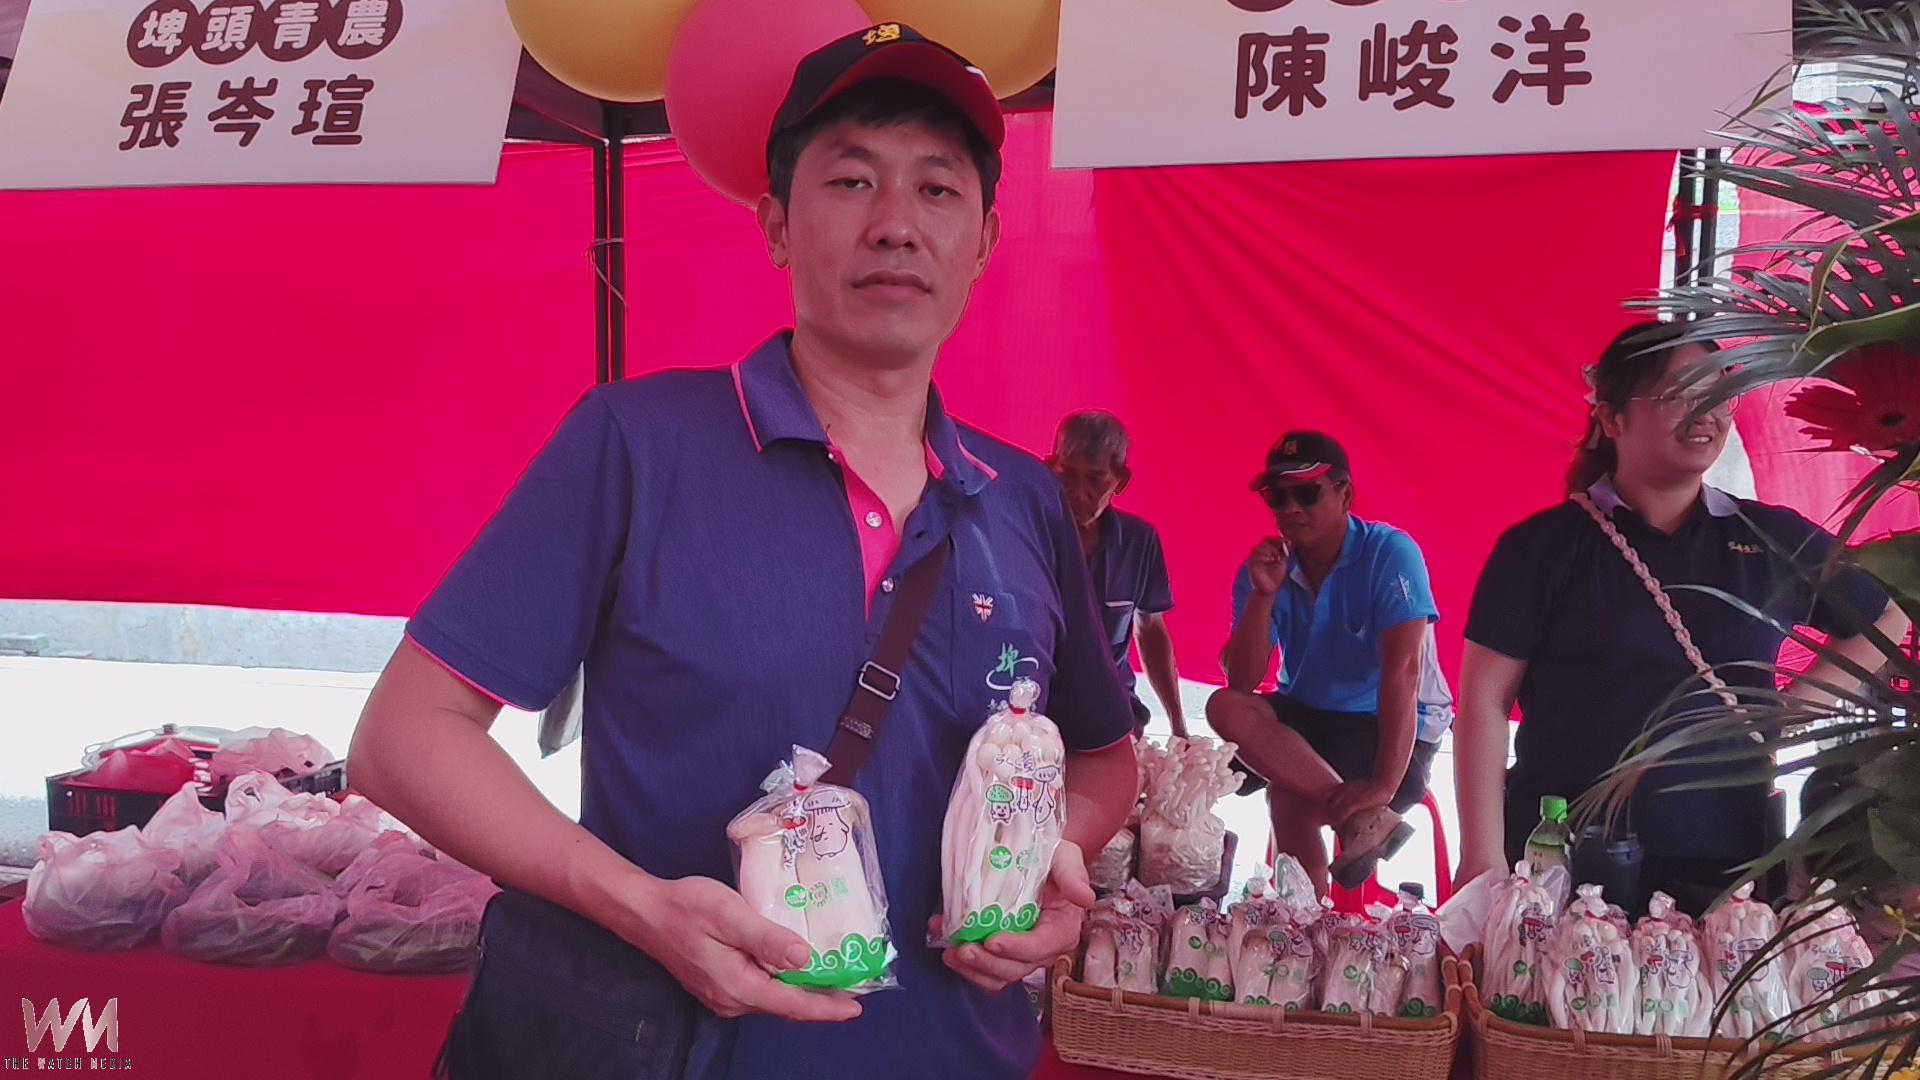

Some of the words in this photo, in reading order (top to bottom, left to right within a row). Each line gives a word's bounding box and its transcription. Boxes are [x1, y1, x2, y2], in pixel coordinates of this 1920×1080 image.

[137, 0, 389, 55] 埤頭青農
[1234, 12, 1592, 119] 陳峻洋
[118, 74, 375, 150] 張岑瑄
